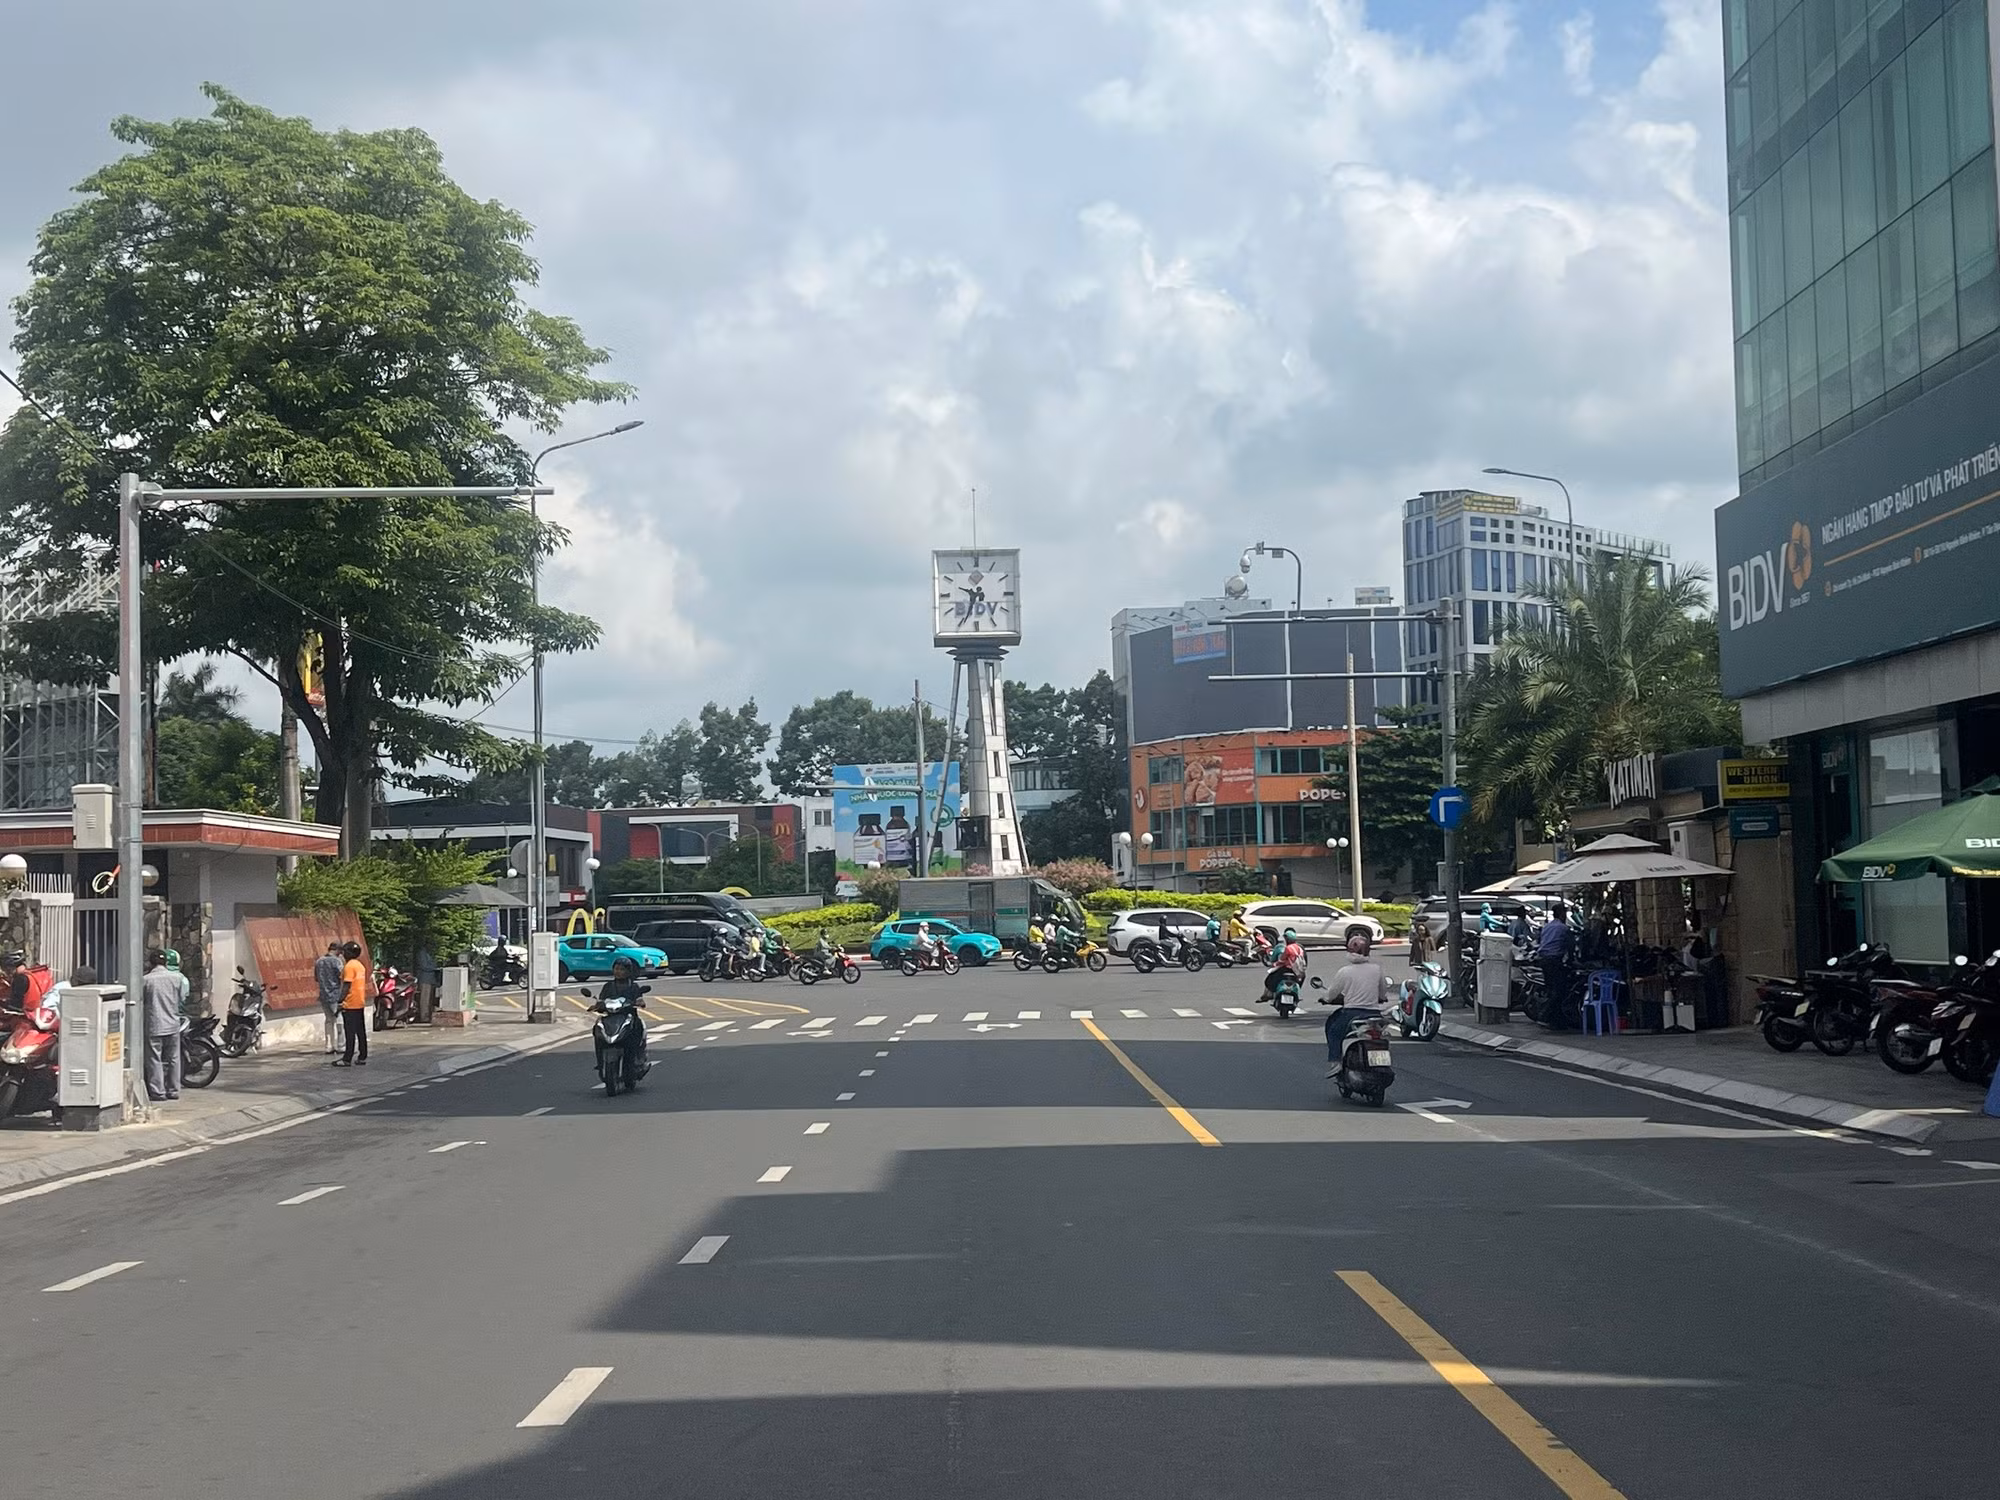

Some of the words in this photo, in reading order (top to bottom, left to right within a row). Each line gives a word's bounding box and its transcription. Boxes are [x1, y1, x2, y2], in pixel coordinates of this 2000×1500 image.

[1869, 495, 1894, 525] TMCP
[1943, 457, 1970, 493] PHÁT
[1728, 542, 1788, 631] BIDV
[1608, 752, 1657, 810] KATINAT
[1727, 766, 1777, 777] WESTERN
[1743, 775, 1778, 784] UNION
[1299, 788, 1347, 800] POPE
